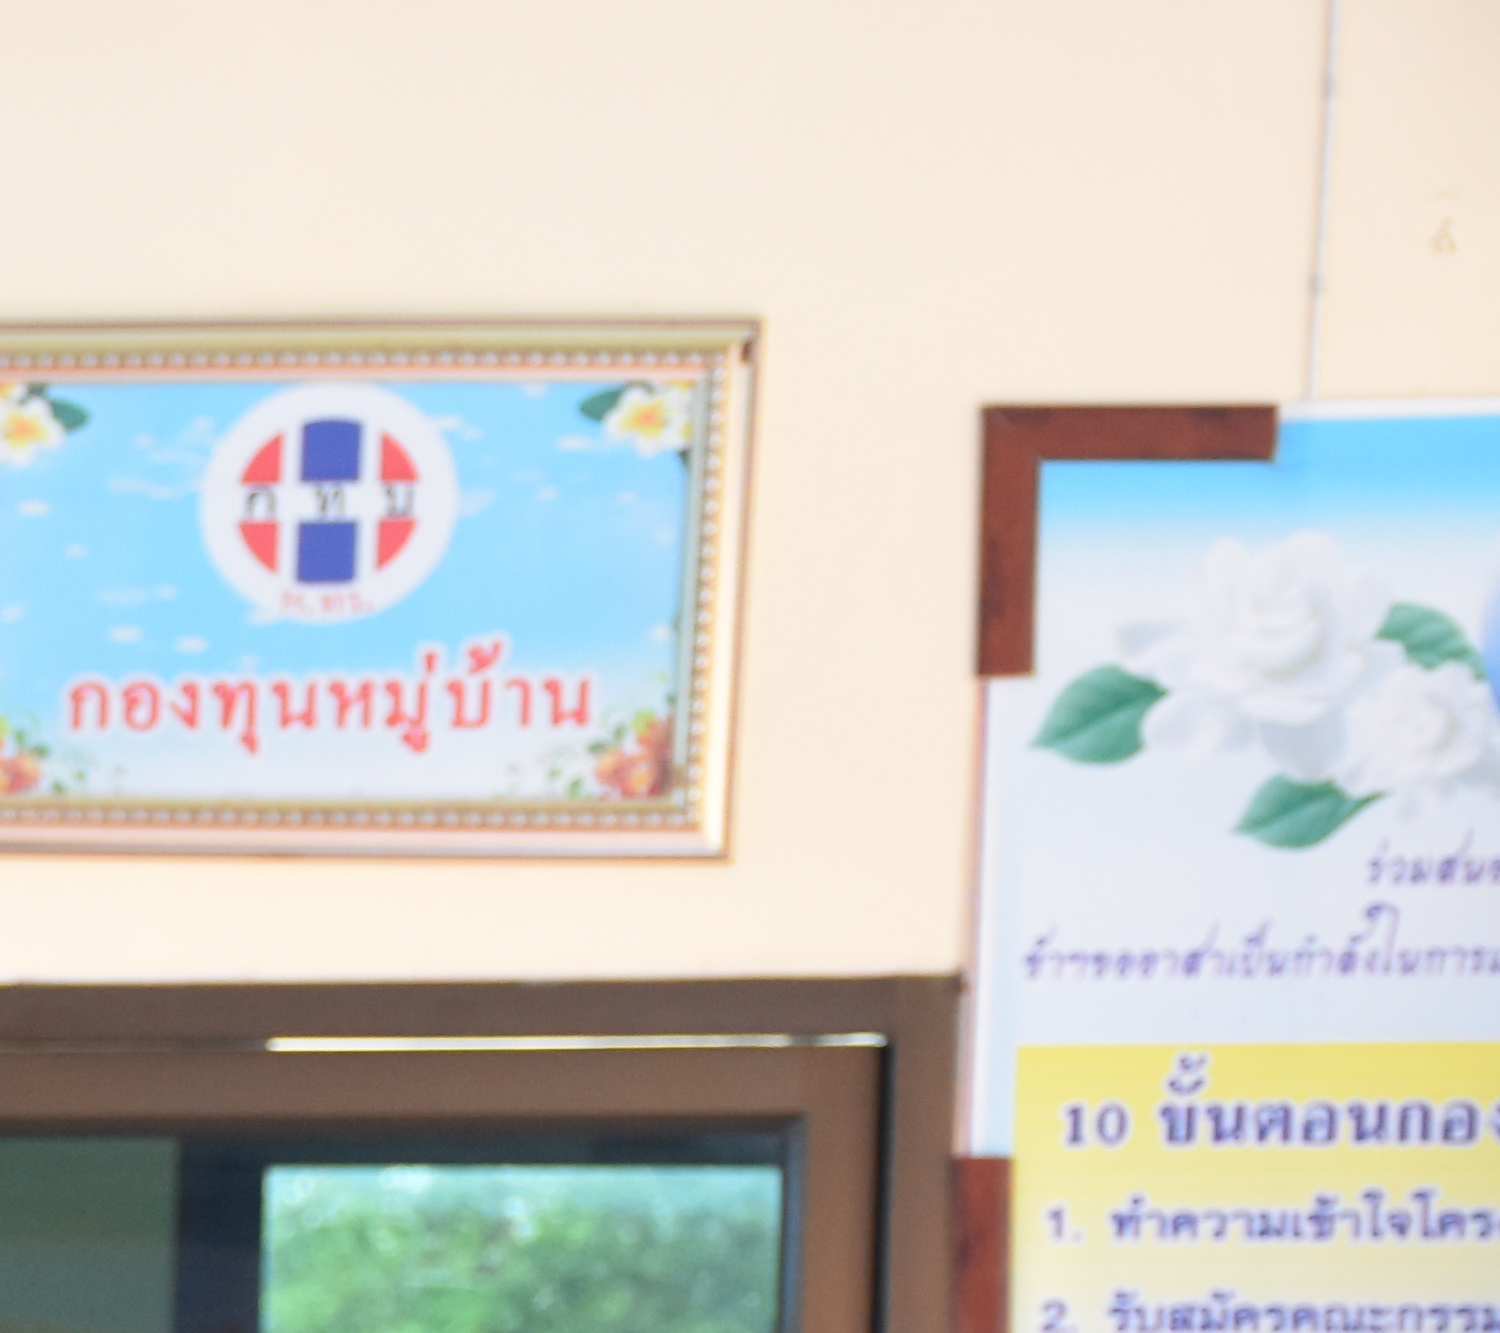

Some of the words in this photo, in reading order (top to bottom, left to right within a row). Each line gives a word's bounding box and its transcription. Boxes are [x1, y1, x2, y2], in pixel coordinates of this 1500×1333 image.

[68, 640, 592, 752] กองทุนหมู่บ้าน
[1066, 1104, 1129, 1146] 10
[1159, 1057, 1500, 1146] ขั้นตอนกอ
[1110, 1189, 1500, 1242] ทำความเข้าใจโคร
